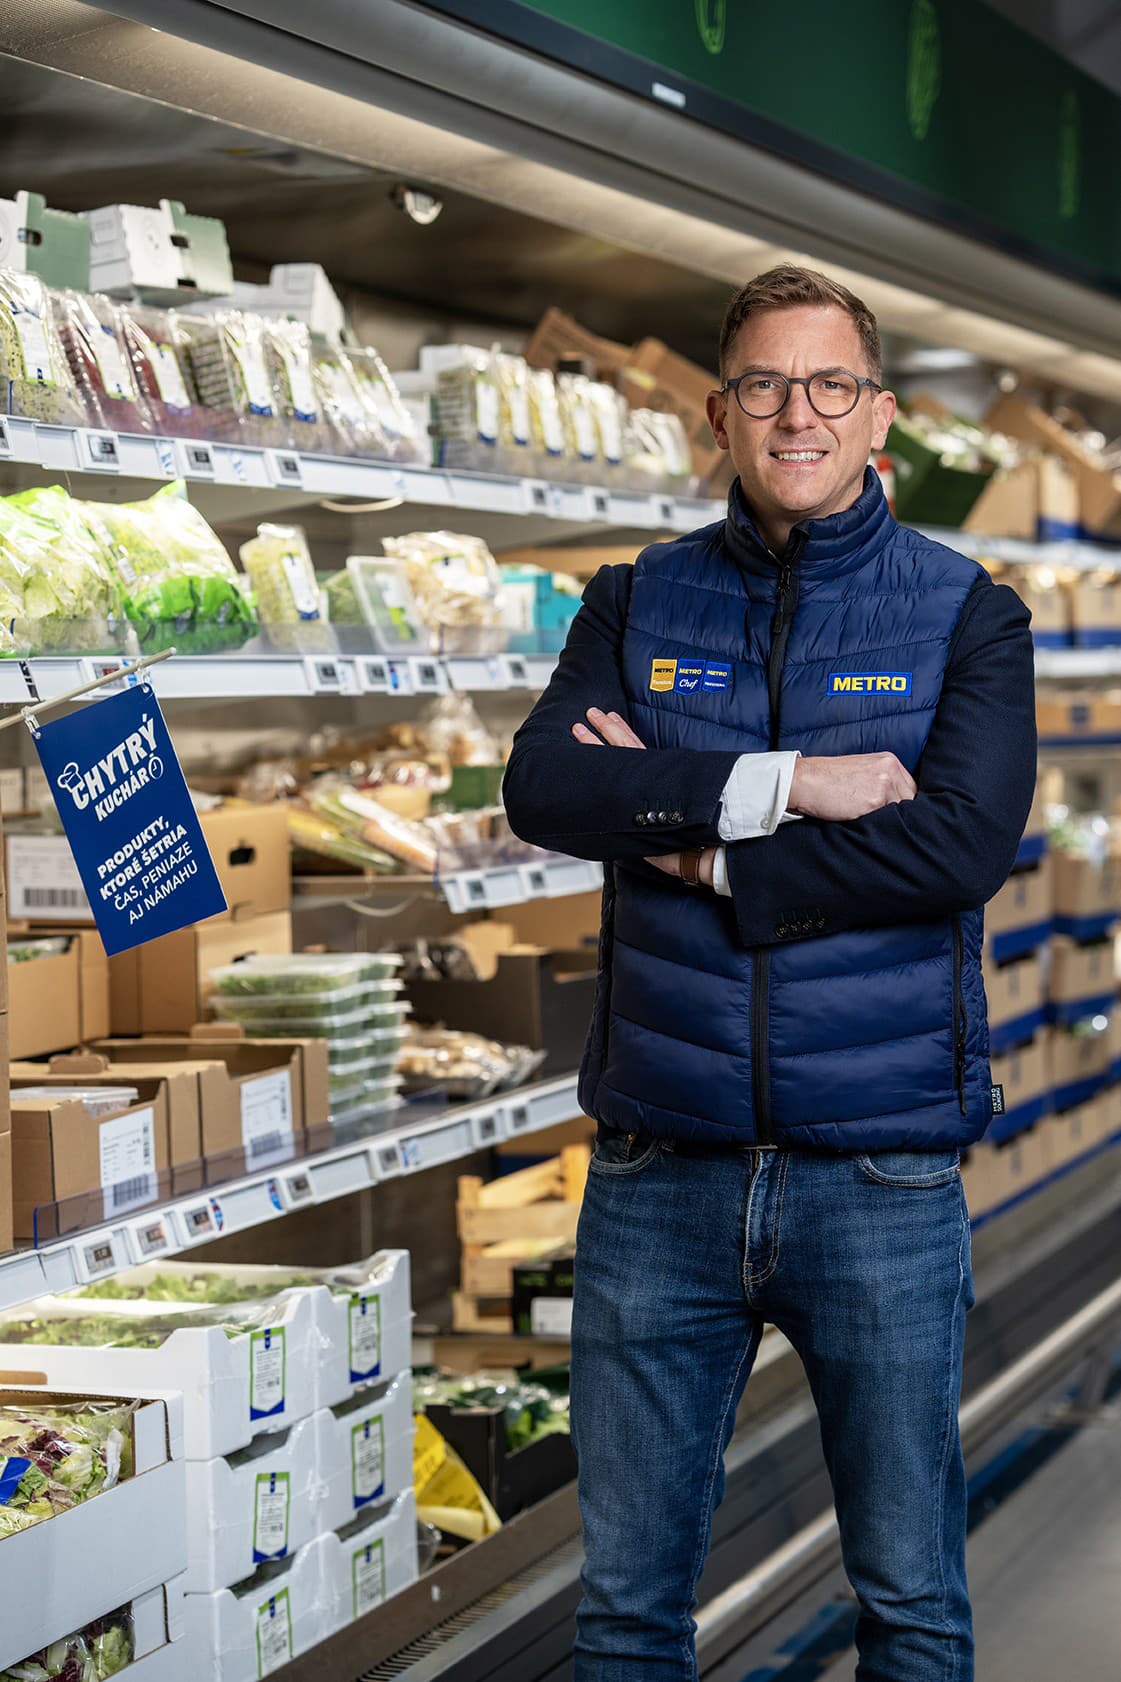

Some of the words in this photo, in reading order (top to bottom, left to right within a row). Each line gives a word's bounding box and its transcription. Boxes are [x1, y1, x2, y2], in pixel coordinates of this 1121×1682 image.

[679, 679, 698, 689] Chef
[833, 676, 907, 691] METRO
[72, 713, 157, 809] CHYTRÝ
[94, 767, 150, 821] KUCHÁR
[97, 816, 170, 879] PRODUKTY,
[100, 857, 142, 900] KTORÉ
[142, 824, 187, 866] ŠETRIA
[114, 883, 143, 911] ČAS,
[142, 841, 193, 889] PENIAZE
[129, 902, 143, 925] AJ
[144, 860, 198, 910] NÁMAHU
